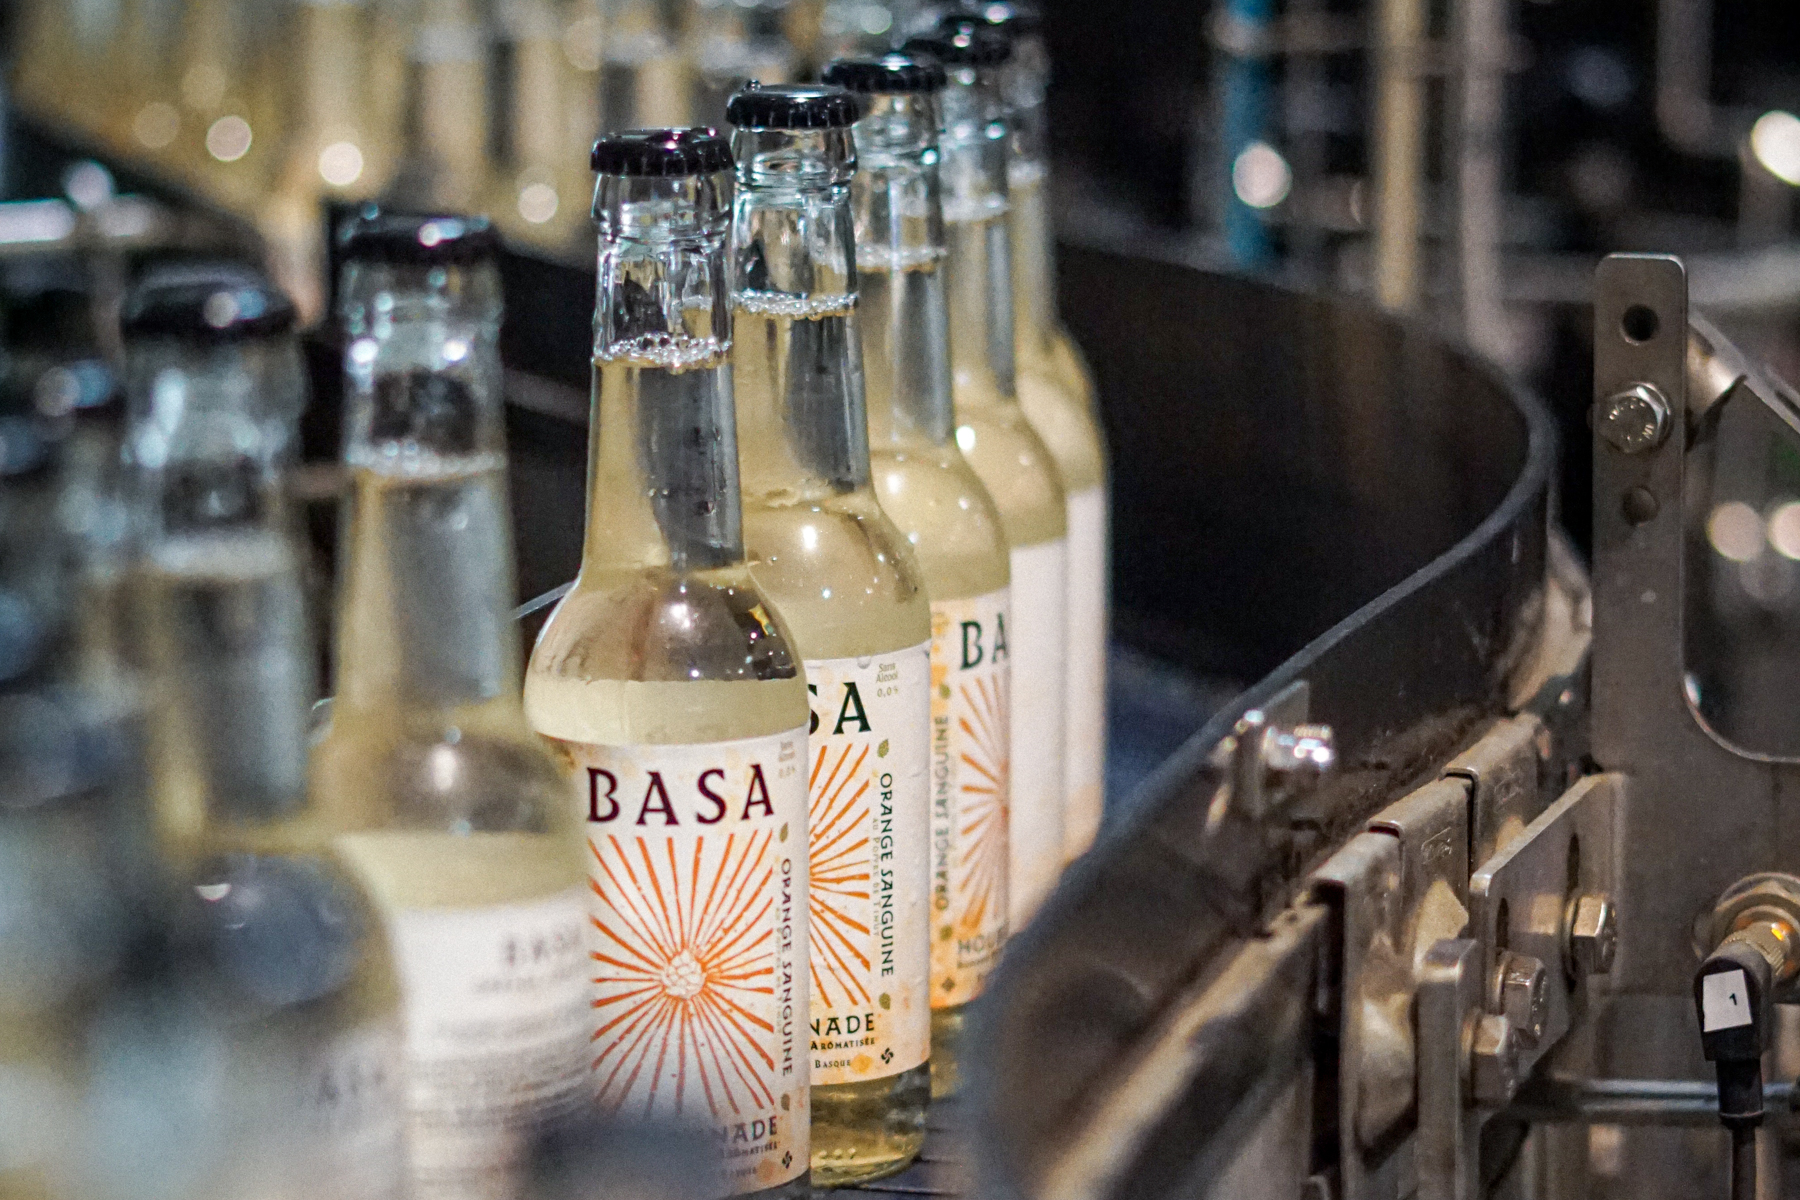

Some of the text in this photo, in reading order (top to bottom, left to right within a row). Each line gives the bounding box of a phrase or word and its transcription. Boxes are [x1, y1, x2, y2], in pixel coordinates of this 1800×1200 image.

[875, 671, 898, 683] Alcool
[586, 763, 775, 826] BASA
[933, 716, 949, 911] ORANGE SANGUINE
[880, 772, 894, 977] ORANGE SANGUINE
[780, 858, 793, 1077] ORANGE SANGUINE
[1729, 993, 1737, 1006] 1
[814, 1059, 851, 1069] BASQUE
